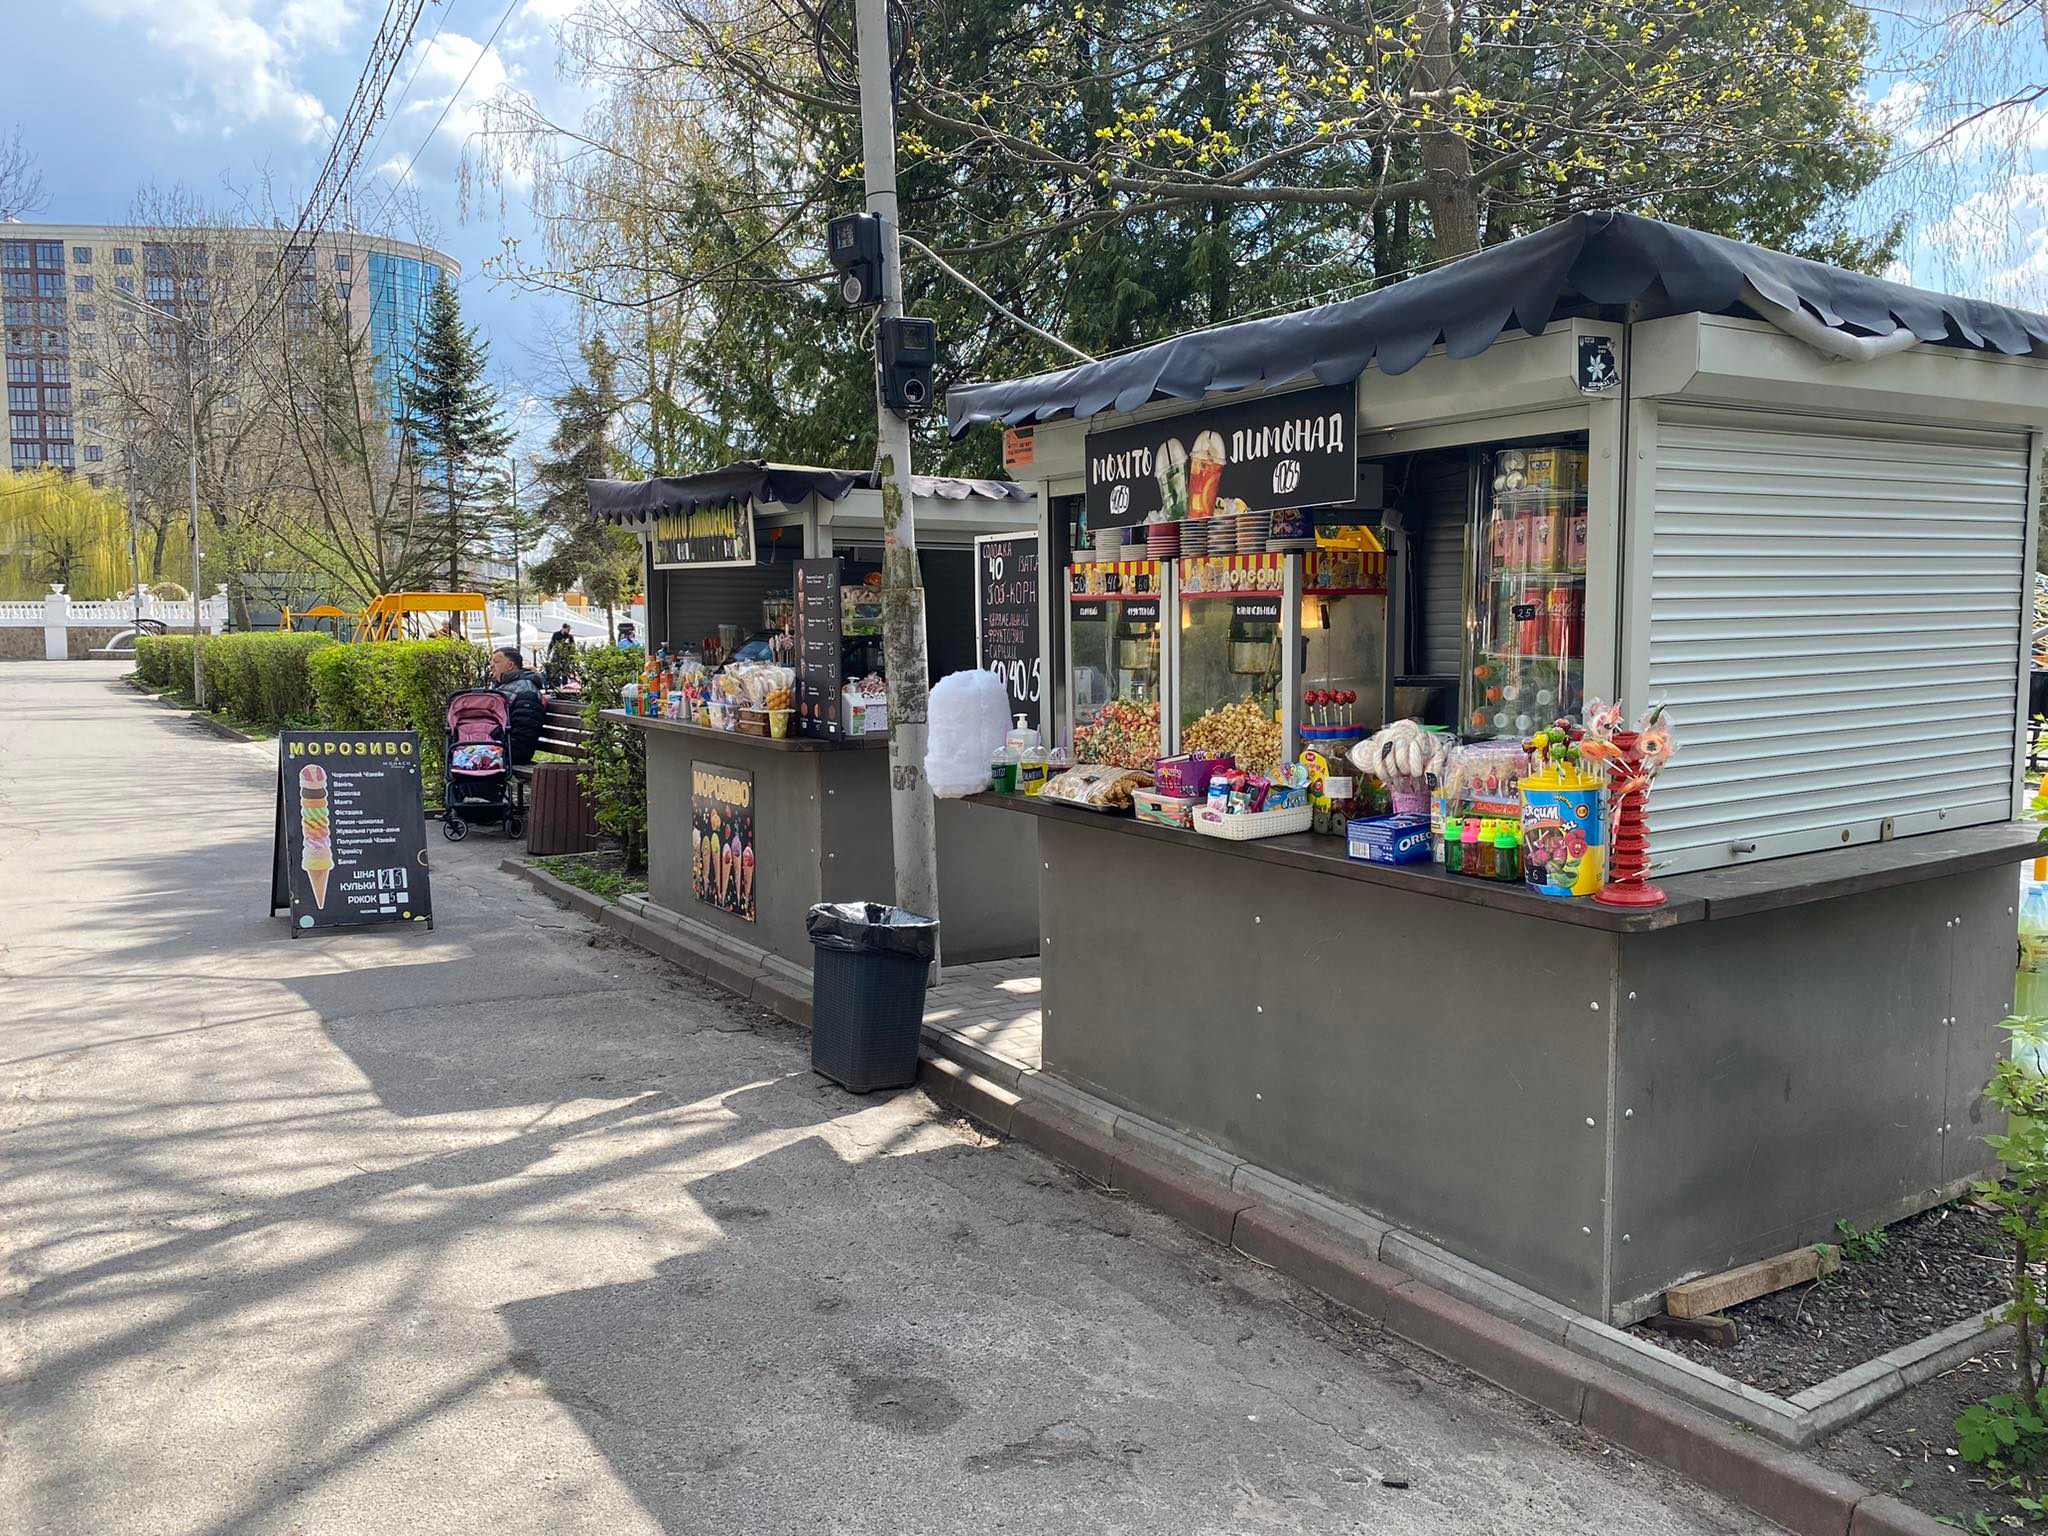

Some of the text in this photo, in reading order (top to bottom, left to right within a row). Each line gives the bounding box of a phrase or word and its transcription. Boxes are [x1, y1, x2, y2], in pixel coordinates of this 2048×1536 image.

[1229, 412, 1344, 464] ЛИМОНАД
[1093, 446, 1152, 485] МОХІТО
[989, 557, 1004, 580] 40
[1074, 576, 1085, 591] 50
[1221, 568, 1283, 587] POPCORN
[1517, 608, 1533, 618] 25
[289, 741, 413, 756] МОРОЗИВО
[693, 770, 750, 808] МОРОЗИВО
[1561, 820, 1577, 831] XL
[1399, 831, 1432, 852] OREO
[1533, 870, 1538, 879] 6
[340, 881, 376, 891] КУЛЬКИ
[347, 892, 396, 904] РІЖОК 5
